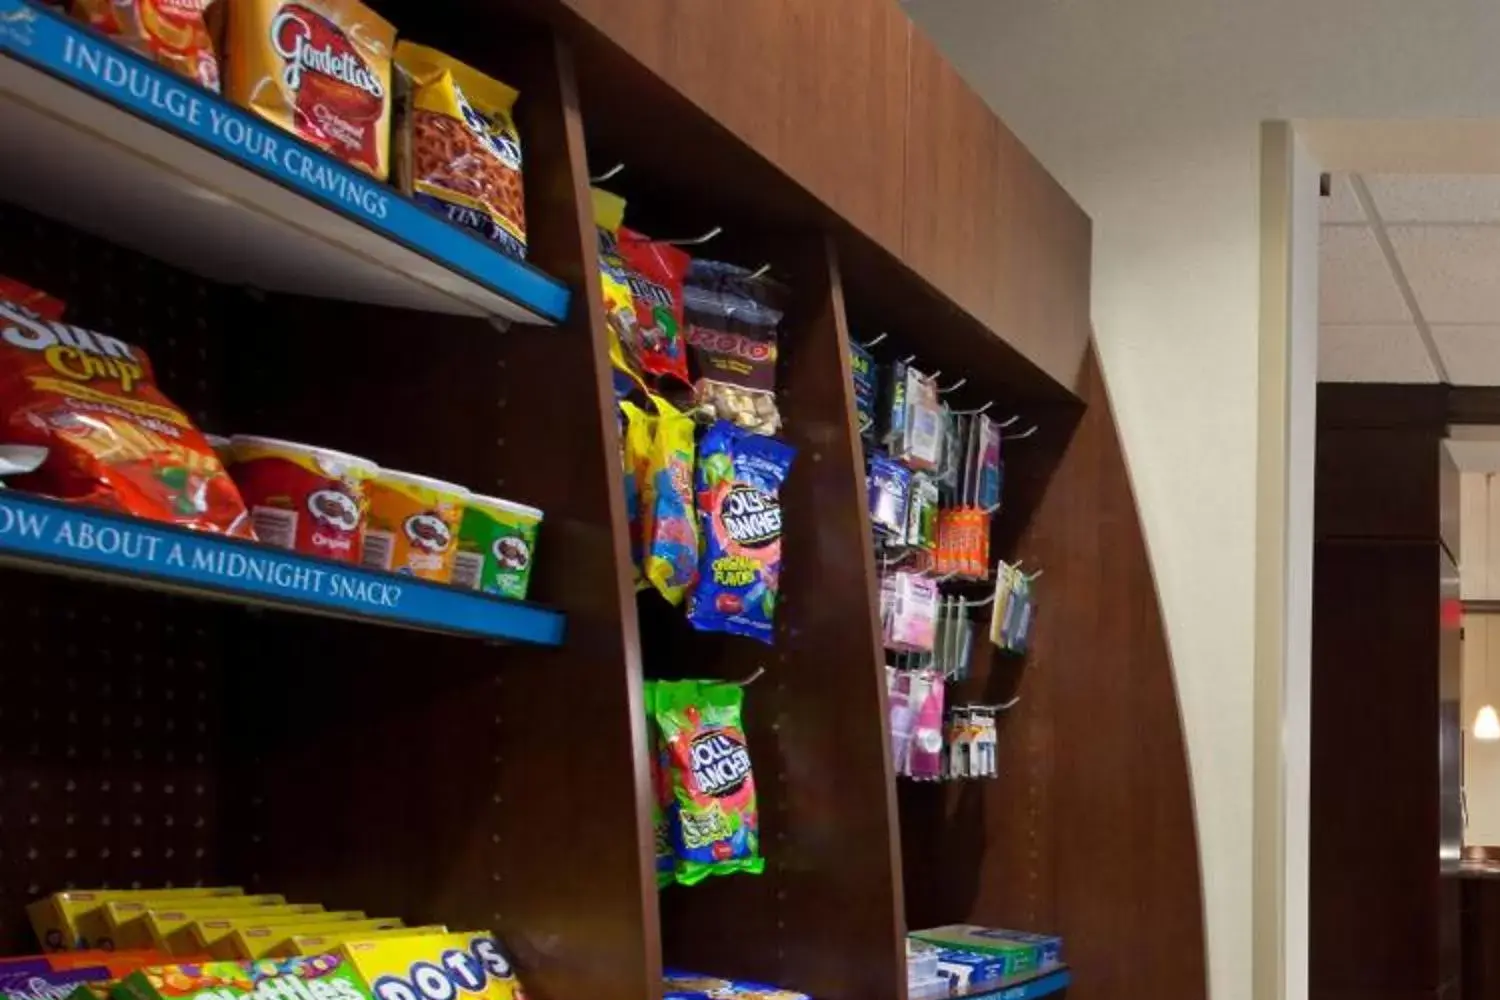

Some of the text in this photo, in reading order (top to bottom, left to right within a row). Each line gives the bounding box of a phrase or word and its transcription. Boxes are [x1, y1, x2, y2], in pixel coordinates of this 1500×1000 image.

[63, 35, 202, 126] INDULGE
[210, 108, 279, 165] YOUR
[283, 150, 389, 220] CRAVINGS
[0, 505, 402, 607] OW ABOUT A MIDNIGHT SNACK?
